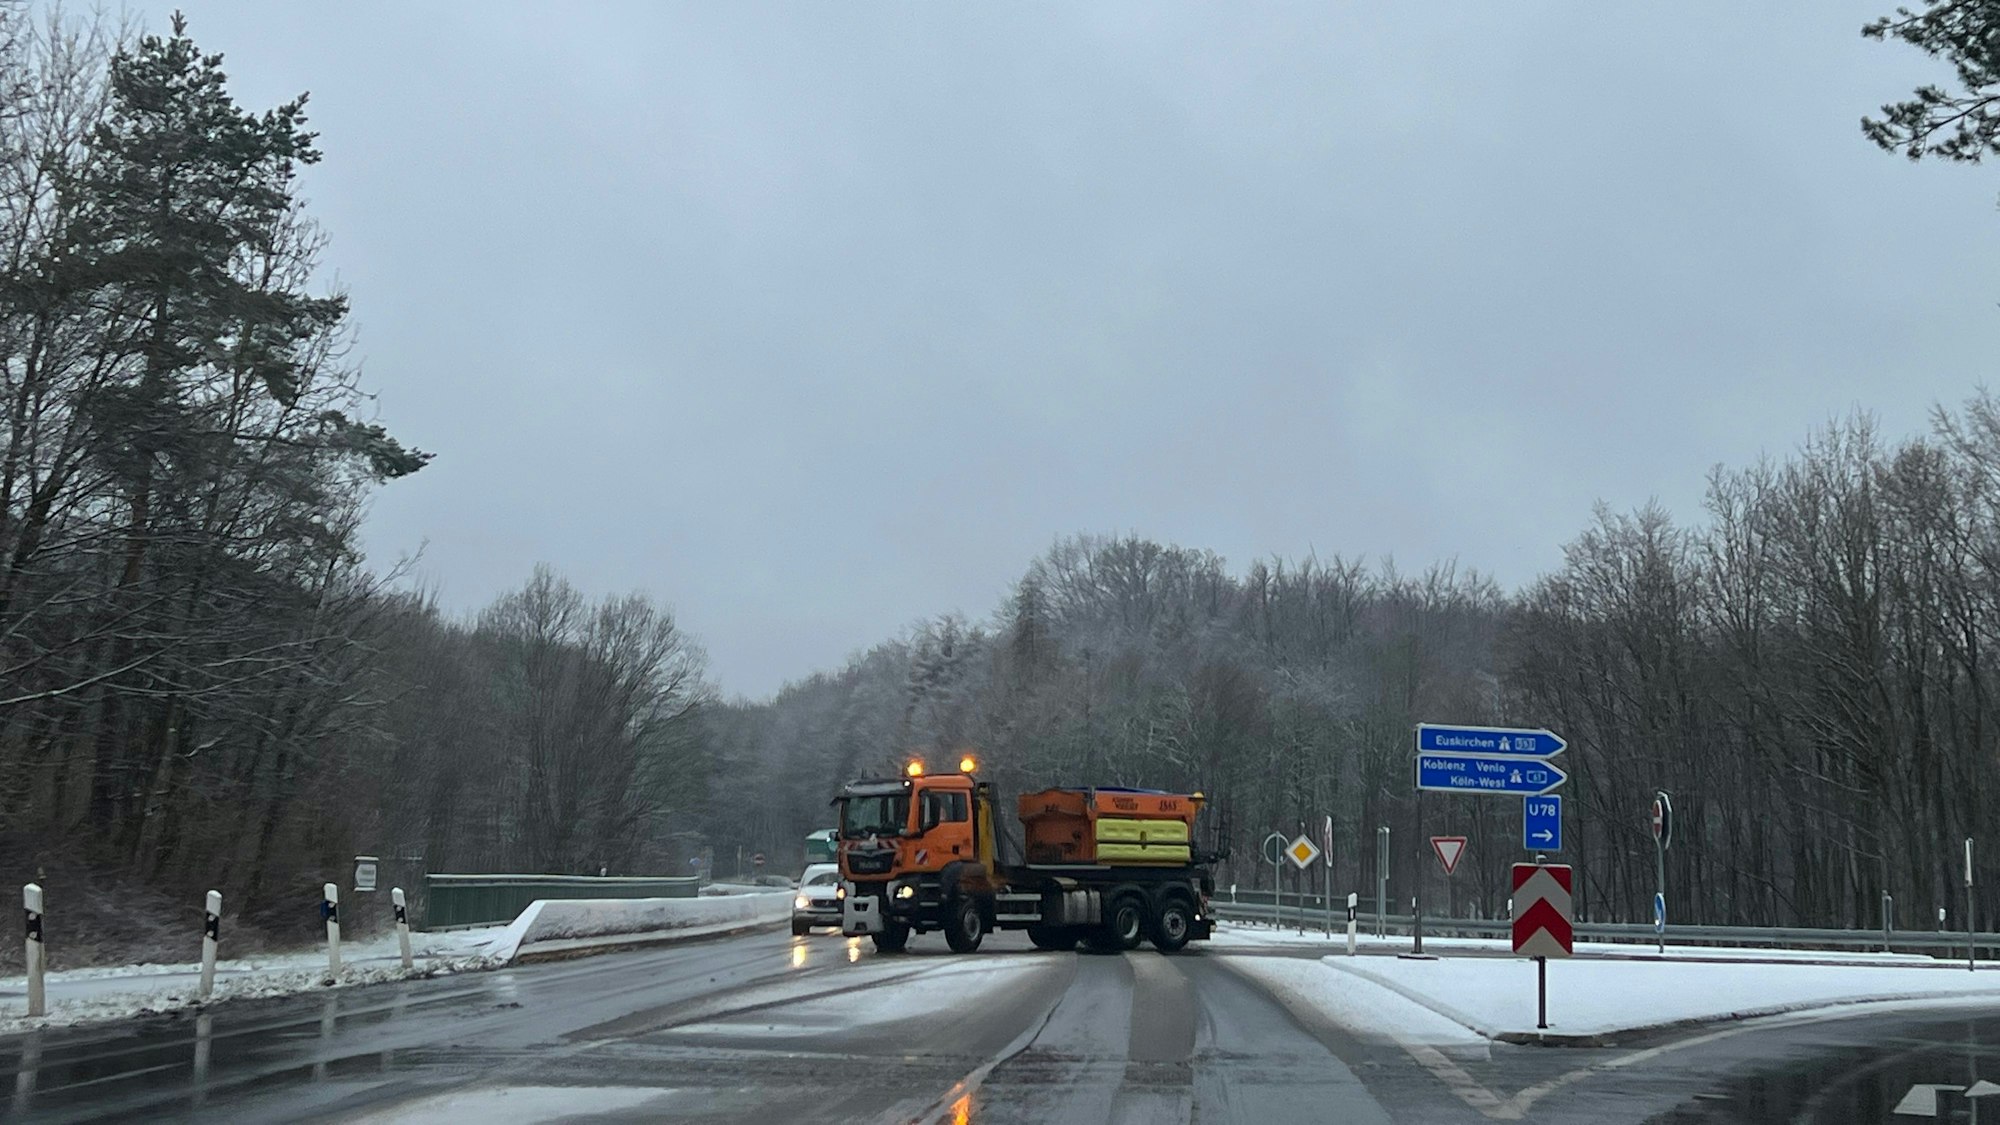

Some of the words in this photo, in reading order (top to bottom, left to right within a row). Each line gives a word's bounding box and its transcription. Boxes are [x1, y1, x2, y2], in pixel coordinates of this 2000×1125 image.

[1435, 735, 1495, 748] Euskirchen
[1423, 759, 1466, 772] Koblenz
[1475, 761, 1506, 774] Venlo
[1450, 776, 1506, 789] Köln-West
[1529, 804, 1539, 816] U
[1540, 804, 1556, 817] 78
